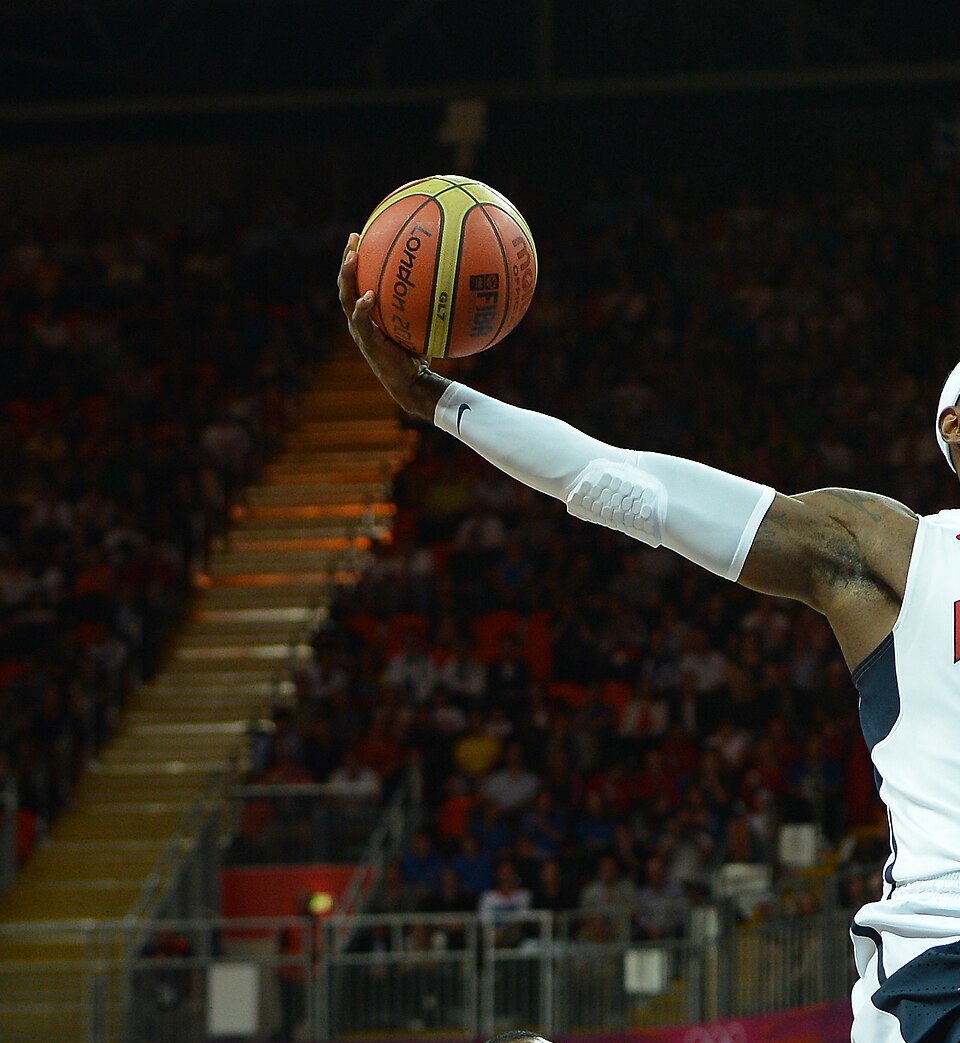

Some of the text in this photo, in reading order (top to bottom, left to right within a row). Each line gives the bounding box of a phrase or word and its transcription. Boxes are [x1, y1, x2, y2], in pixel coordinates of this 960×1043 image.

[392, 224, 432, 311] London
[437, 291, 449, 321] GL7
[475, 291, 500, 337] FIBA
